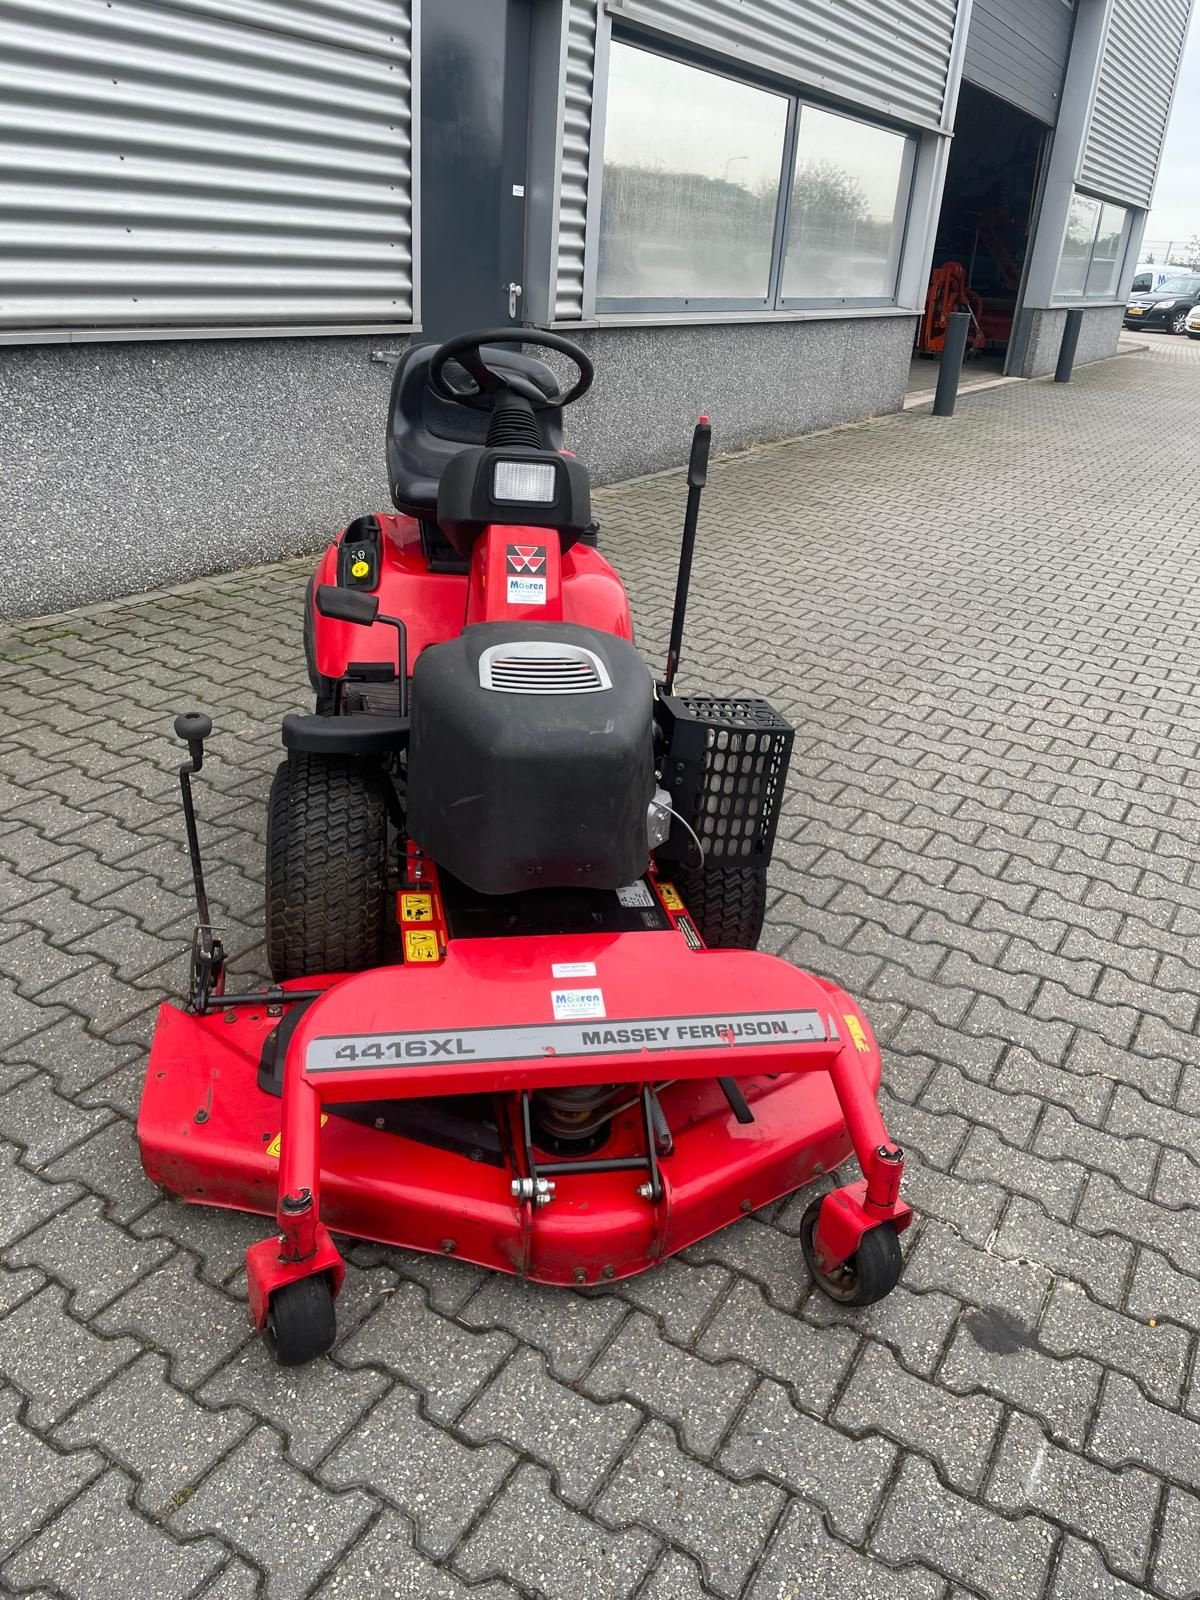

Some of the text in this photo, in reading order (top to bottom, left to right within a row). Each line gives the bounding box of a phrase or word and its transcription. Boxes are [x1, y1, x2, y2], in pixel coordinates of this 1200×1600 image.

[510, 580, 544, 590] Mooren
[556, 993, 600, 1004] Mooren
[581, 1020, 789, 1046] MASSEY FERGUSON
[335, 1038, 475, 1061] 4416XL
